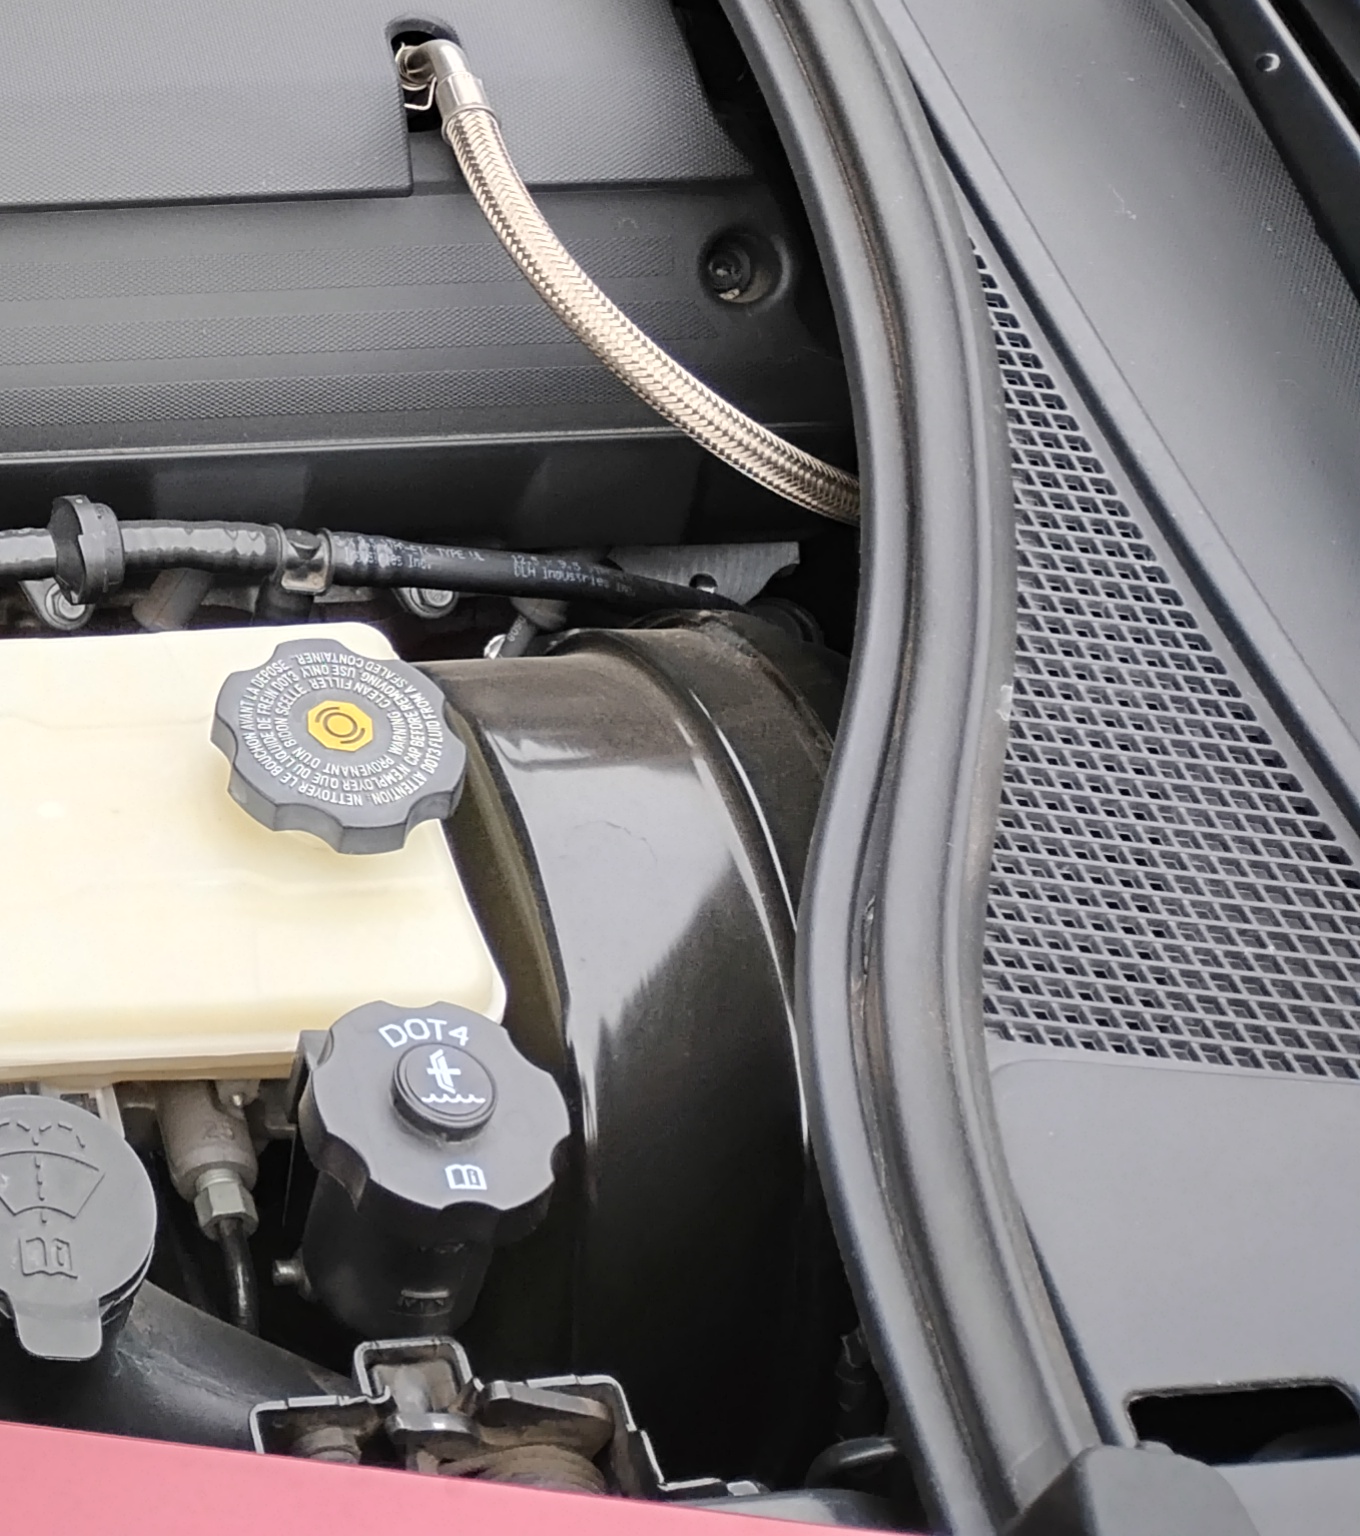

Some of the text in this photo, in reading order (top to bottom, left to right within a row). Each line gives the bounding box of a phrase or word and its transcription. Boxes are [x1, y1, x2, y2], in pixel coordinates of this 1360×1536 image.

[271, 670, 300, 691] DOT3
[300, 664, 330, 678] ONLY
[308, 676, 353, 690] FILLER
[332, 664, 356, 678] USE
[365, 661, 408, 688] SEALED
[243, 687, 260, 700] LA
[257, 687, 279, 715] FREIN
[353, 682, 391, 708] CLEAN
[404, 684, 417, 693] A
[239, 700, 255, 730] AVANT
[409, 692, 438, 719] FROM
[256, 717, 272, 729] DE
[274, 717, 297, 747] BIDON
[404, 711, 425, 747] BEFORE
[425, 720, 444, 749] FLUID
[242, 732, 284, 776] BOUCHON
[260, 731, 296, 768] LIQUIDE
[403, 747, 422, 765] CAP
[420, 748, 442, 774] DOT3
[292, 763, 311, 779] DU
[322, 754, 395, 777] PROVENANT
[279, 772, 298, 787] LE
[311, 772, 339, 789] QUE
[298, 781, 363, 806] NETTOYER
[378, 1017, 470, 1048] DOT4
